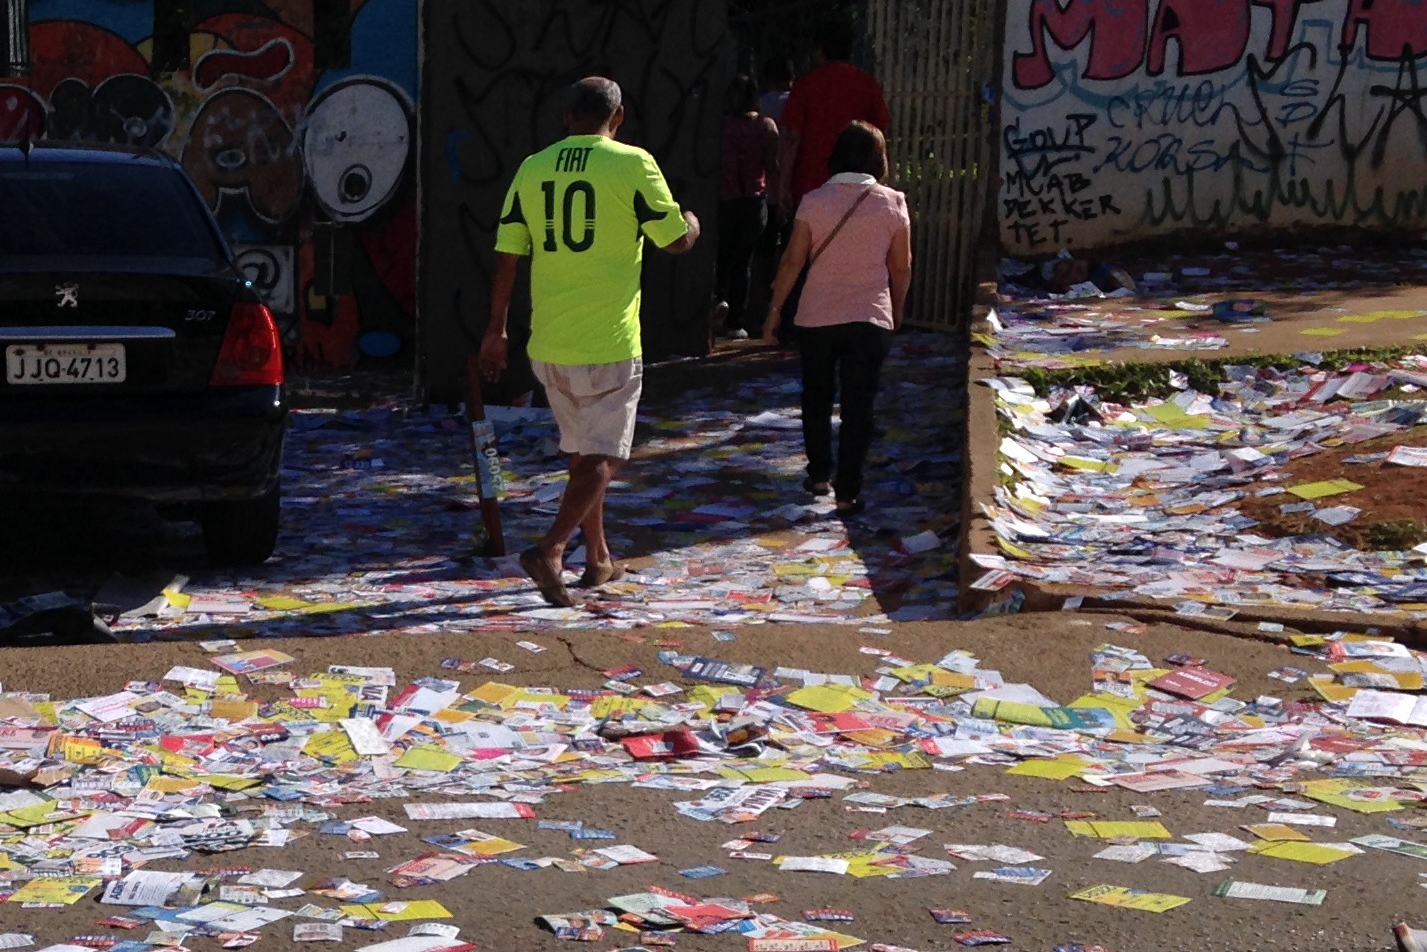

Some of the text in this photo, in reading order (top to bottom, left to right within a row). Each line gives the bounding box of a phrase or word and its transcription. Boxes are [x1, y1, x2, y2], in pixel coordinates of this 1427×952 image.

[555, 147, 594, 173] FIAT
[541, 180, 596, 253] 10
[185, 309, 216, 321] 307
